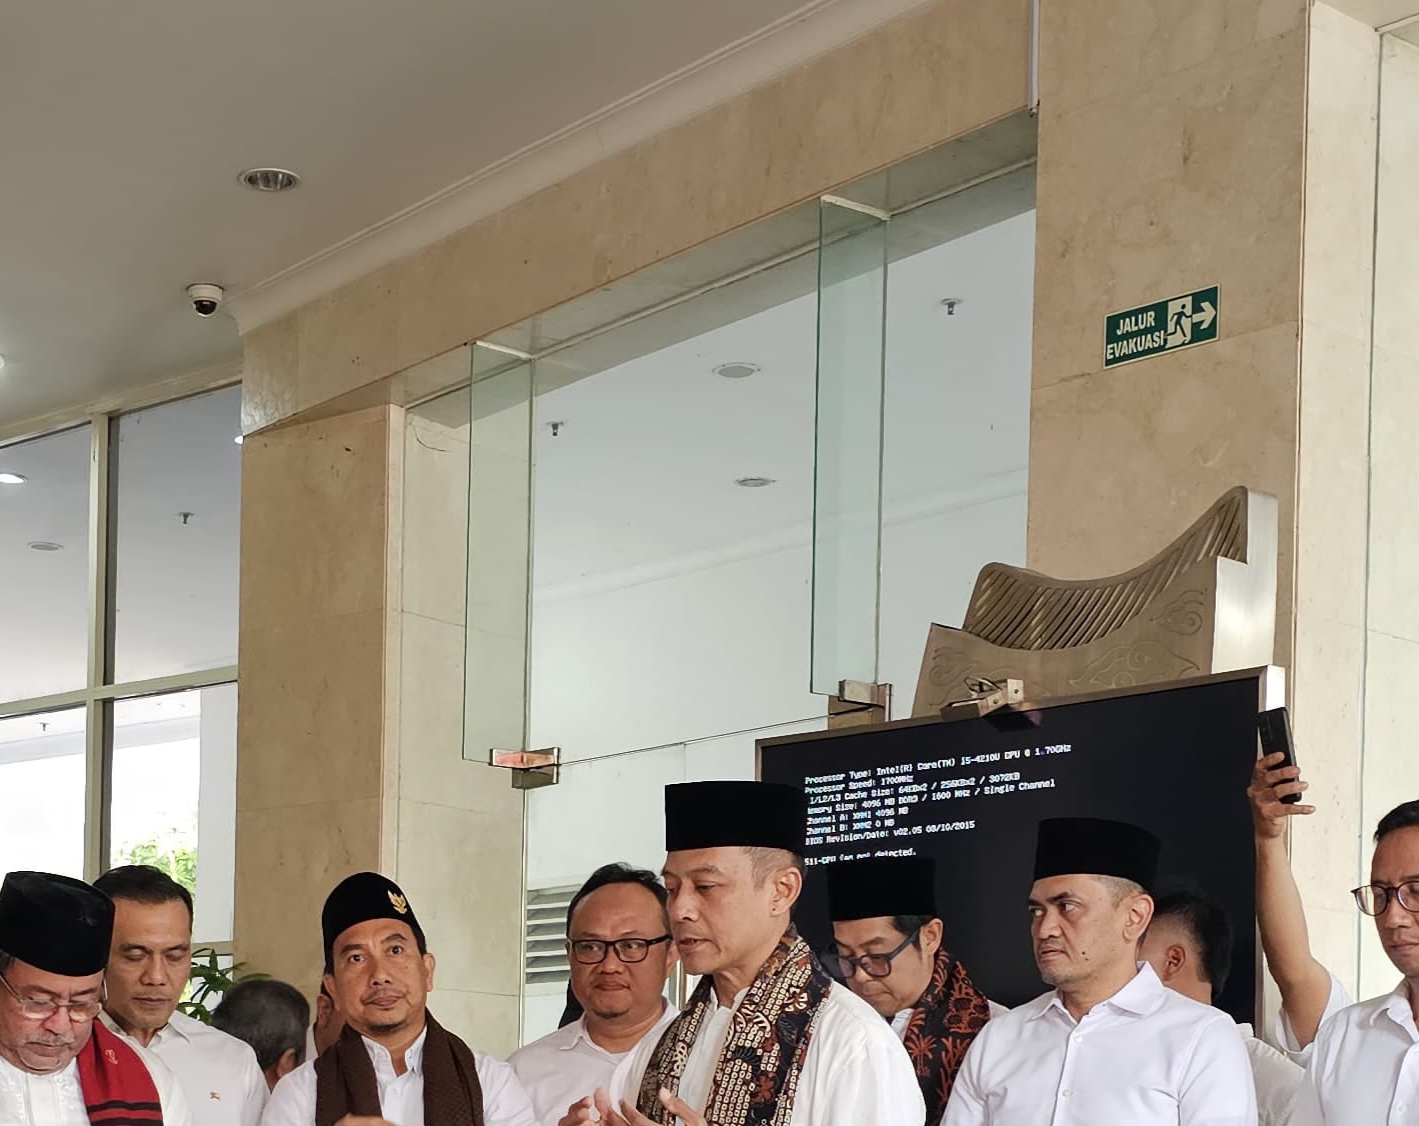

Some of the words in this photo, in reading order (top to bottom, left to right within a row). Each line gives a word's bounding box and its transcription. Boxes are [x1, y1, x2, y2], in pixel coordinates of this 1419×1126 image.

[1116, 311, 1155, 335] JALUR
[1106, 330, 1164, 360] EVAKUASI
[804, 773, 845, 785] Processor
[1004, 750, 1020, 760] CPU
[804, 783, 845, 795] Processor
[931, 791, 951, 801] 1600
[984, 784, 1015, 795] Single
[1018, 778, 1055, 791] Channel
